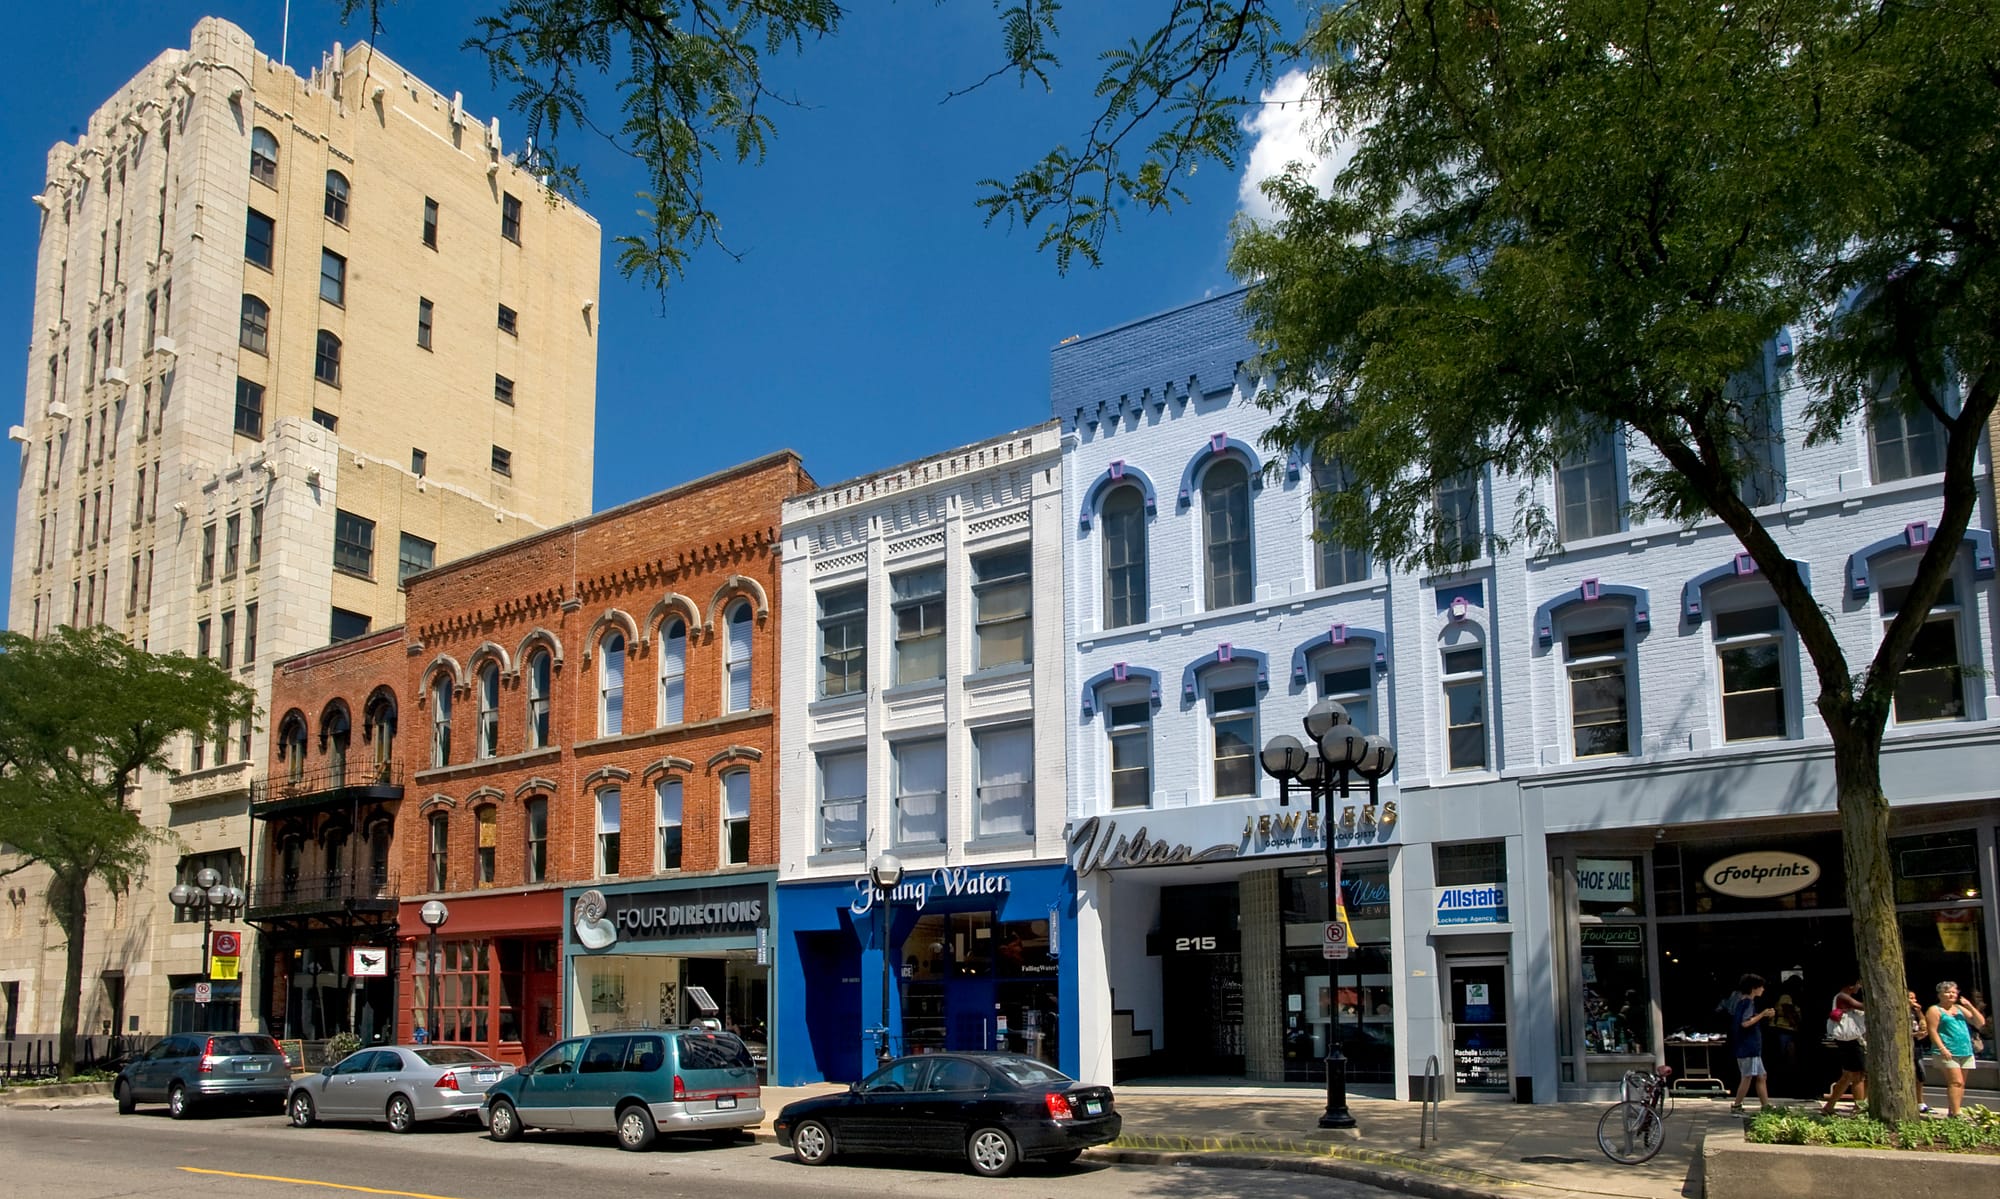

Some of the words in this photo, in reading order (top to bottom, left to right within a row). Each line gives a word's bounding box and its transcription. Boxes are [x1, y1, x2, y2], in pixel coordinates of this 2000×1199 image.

[1242, 801, 1398, 837] JEWEERS
[1071, 816, 1239, 878] Urban
[1265, 836, 1312, 848] GOLDSMITHS
[1314, 836, 1320, 844] &
[1321, 830, 1376, 843] GOLOGISTS
[1577, 871, 1605, 890] SHOE
[1607, 871, 1631, 891] SALE
[1713, 862, 1810, 886] Footprints
[850, 877, 926, 915] Faling
[931, 866, 1008, 897] Water
[1437, 888, 1504, 908] Allstate
[616, 907, 668, 929] FOUR
[669, 900, 762, 927] DIRECTIONS
[1175, 936, 1217, 951] 215
